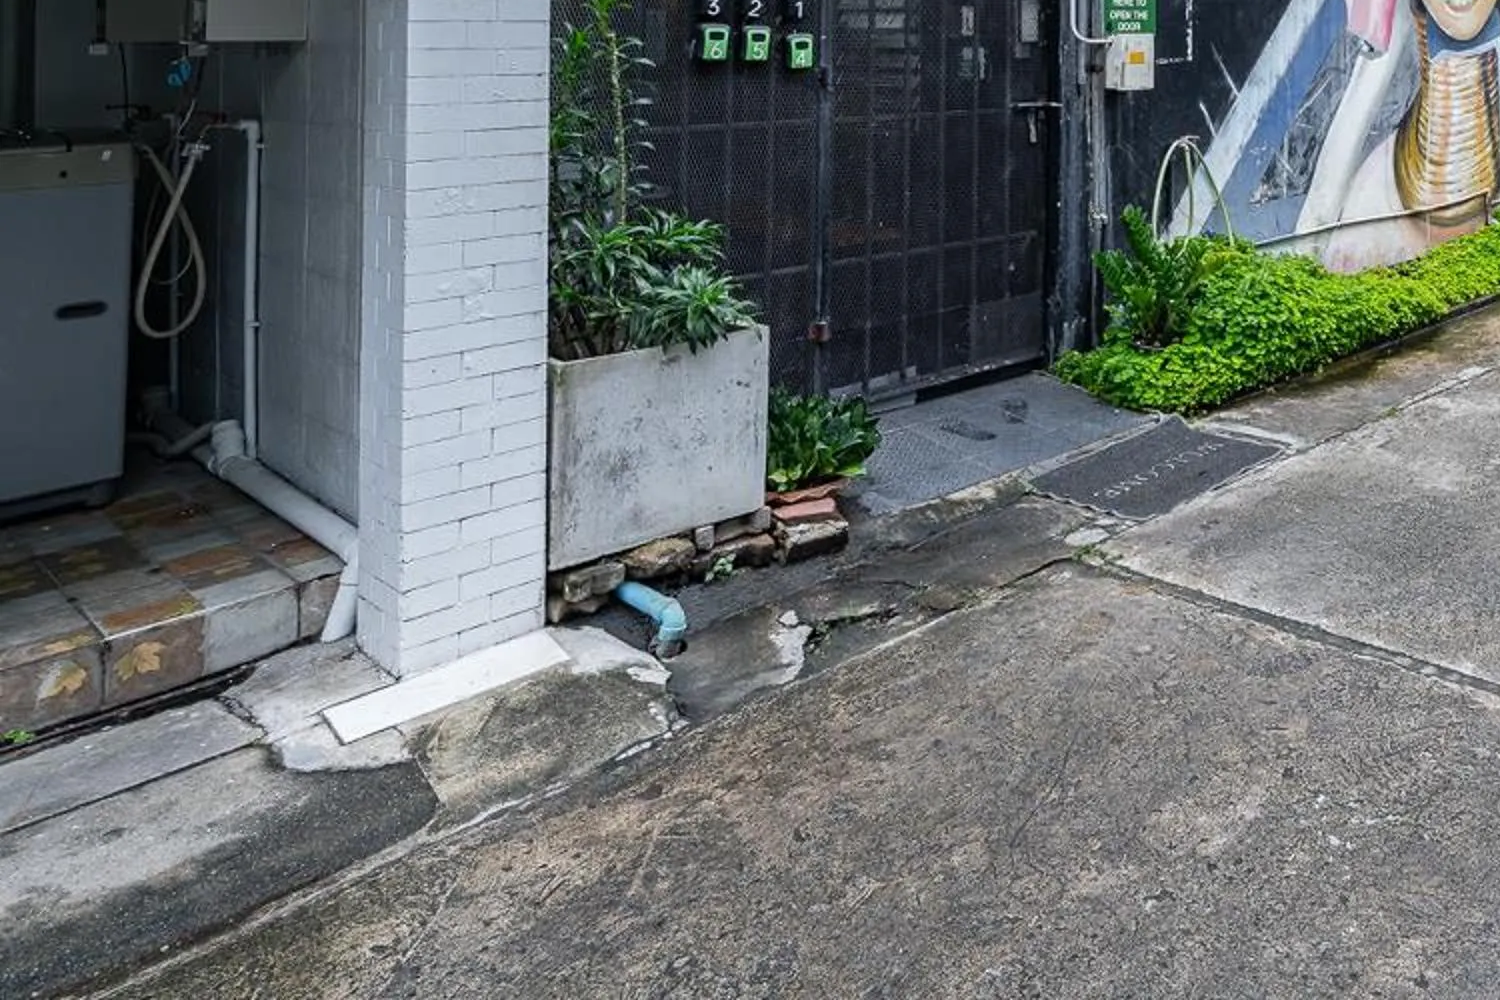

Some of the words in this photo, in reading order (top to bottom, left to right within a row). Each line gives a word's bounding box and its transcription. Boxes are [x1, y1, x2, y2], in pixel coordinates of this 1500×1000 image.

[747, 0, 761, 17] 2
[795, 1, 803, 18] 1
[1109, 10, 1132, 20] OPEN
[1133, 10, 1149, 21] THE
[1117, 21, 1141, 31] DOOR
[711, 41, 723, 59] 6
[752, 42, 764, 59] 5
